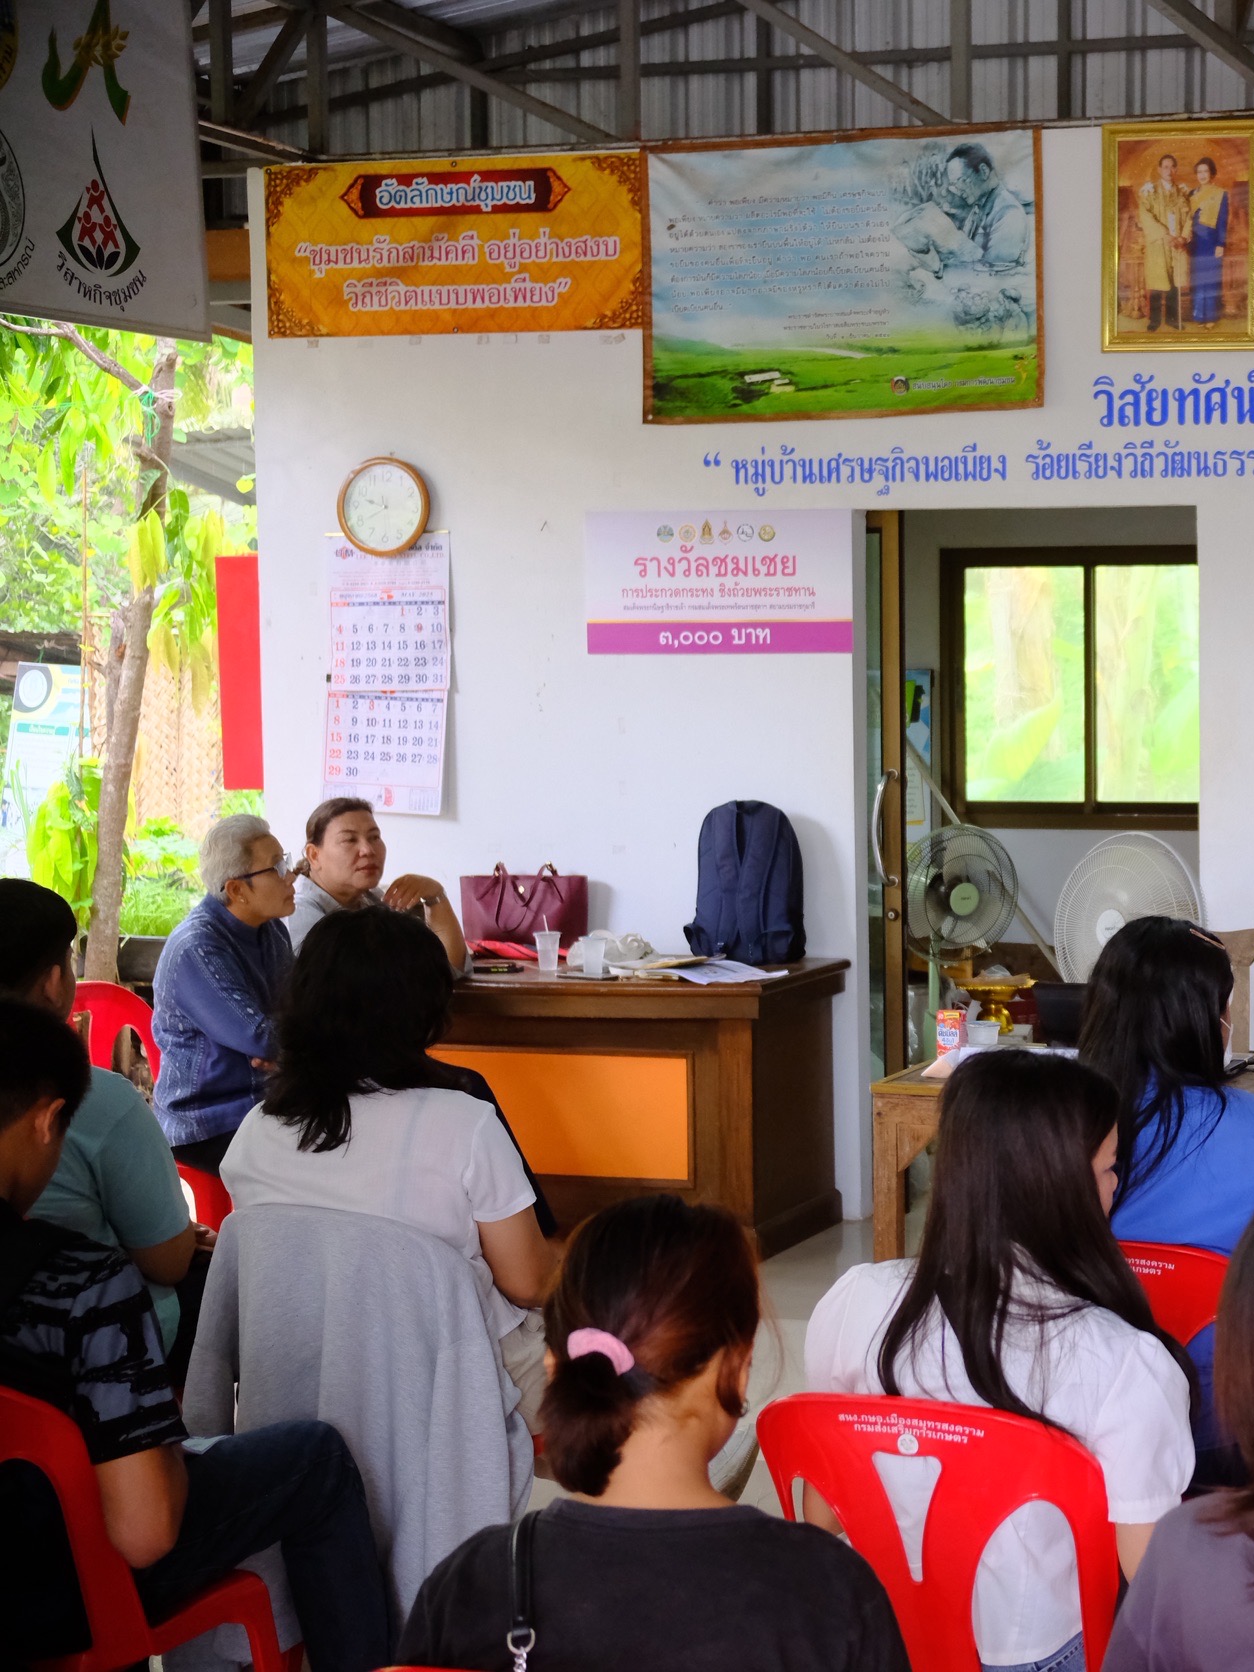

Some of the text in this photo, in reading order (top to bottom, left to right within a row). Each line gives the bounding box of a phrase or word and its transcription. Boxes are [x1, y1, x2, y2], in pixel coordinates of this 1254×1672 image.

[377, 174, 534, 211] อัตลักษณ์ชุมชน
[486, 230, 619, 271] อยู่อย่างสงบ
[56, 251, 147, 312] วิสาหกิจชุมชน
[731, 444, 1008, 497] หมู่บ้านเศรษฐกิจพอเพียง
[634, 544, 798, 578] รางวัลชมเชย
[621, 581, 817, 599] การประกวดกระทง ชิงถ้วยพระราชทาน
[401, 606, 440, 616] 1 2 3
[337, 623, 443, 634] 4 5 6 7 8 9 10
[659, 626, 771, 647] ๓,๐๐๐ บาท
[335, 640, 443, 651] 11 12 13 14 15 16 17
[335, 657, 444, 668] 18 19 20 21 22 23 24
[334, 673, 444, 684] 25 26 27 28 29 30 31
[335, 699, 438, 713] 1 2 3 4 5 6 7
[334, 715, 439, 730] 8 9 10 11 12 13 14
[330, 733, 438, 747] 15 16 17 18 19 20 21
[329, 749, 438, 764] 22 23 24 25 26 27 28
[328, 765, 358, 777] 29 30
